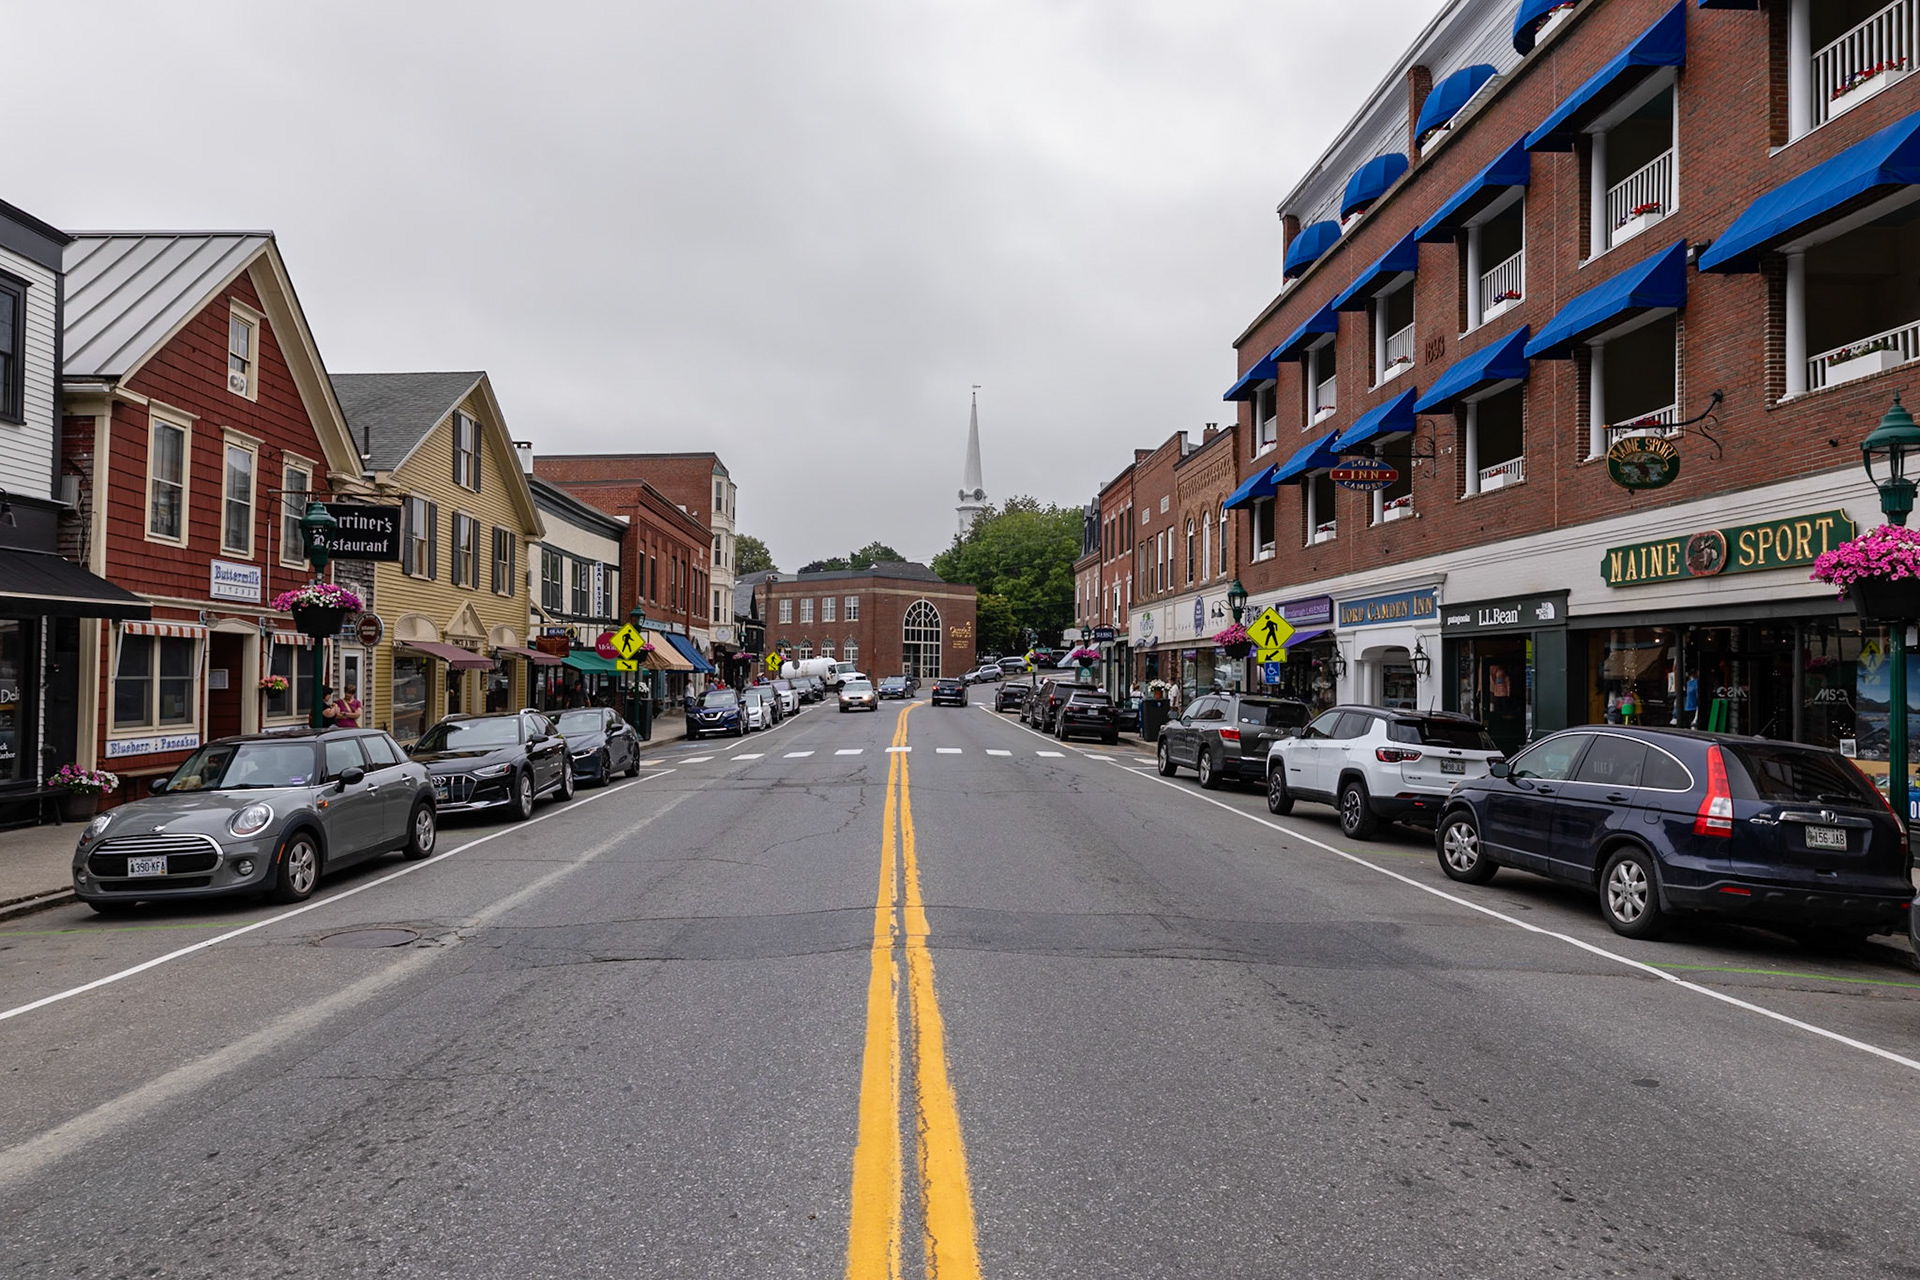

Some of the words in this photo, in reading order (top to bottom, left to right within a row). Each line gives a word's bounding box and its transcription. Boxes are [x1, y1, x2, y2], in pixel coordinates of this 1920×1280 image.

[1425, 334, 1445, 366] 1893
[1610, 438, 1641, 462] MAINE
[1645, 438, 1678, 460] SPORT
[1351, 460, 1379, 468] LORD
[1344, 480, 1383, 490] CAMDEN
[1351, 470, 1379, 480] INN
[338, 512, 393, 534] rriner's
[1610, 542, 1681, 583] MAINE
[1738, 517, 1834, 567] SPORT
[214, 565, 260, 585] Buttermilk
[1341, 606, 1364, 624] LORD
[1367, 601, 1409, 621] CAMDEN
[1413, 595, 1434, 616] INN
[160, 736, 197, 750] Pancakes
